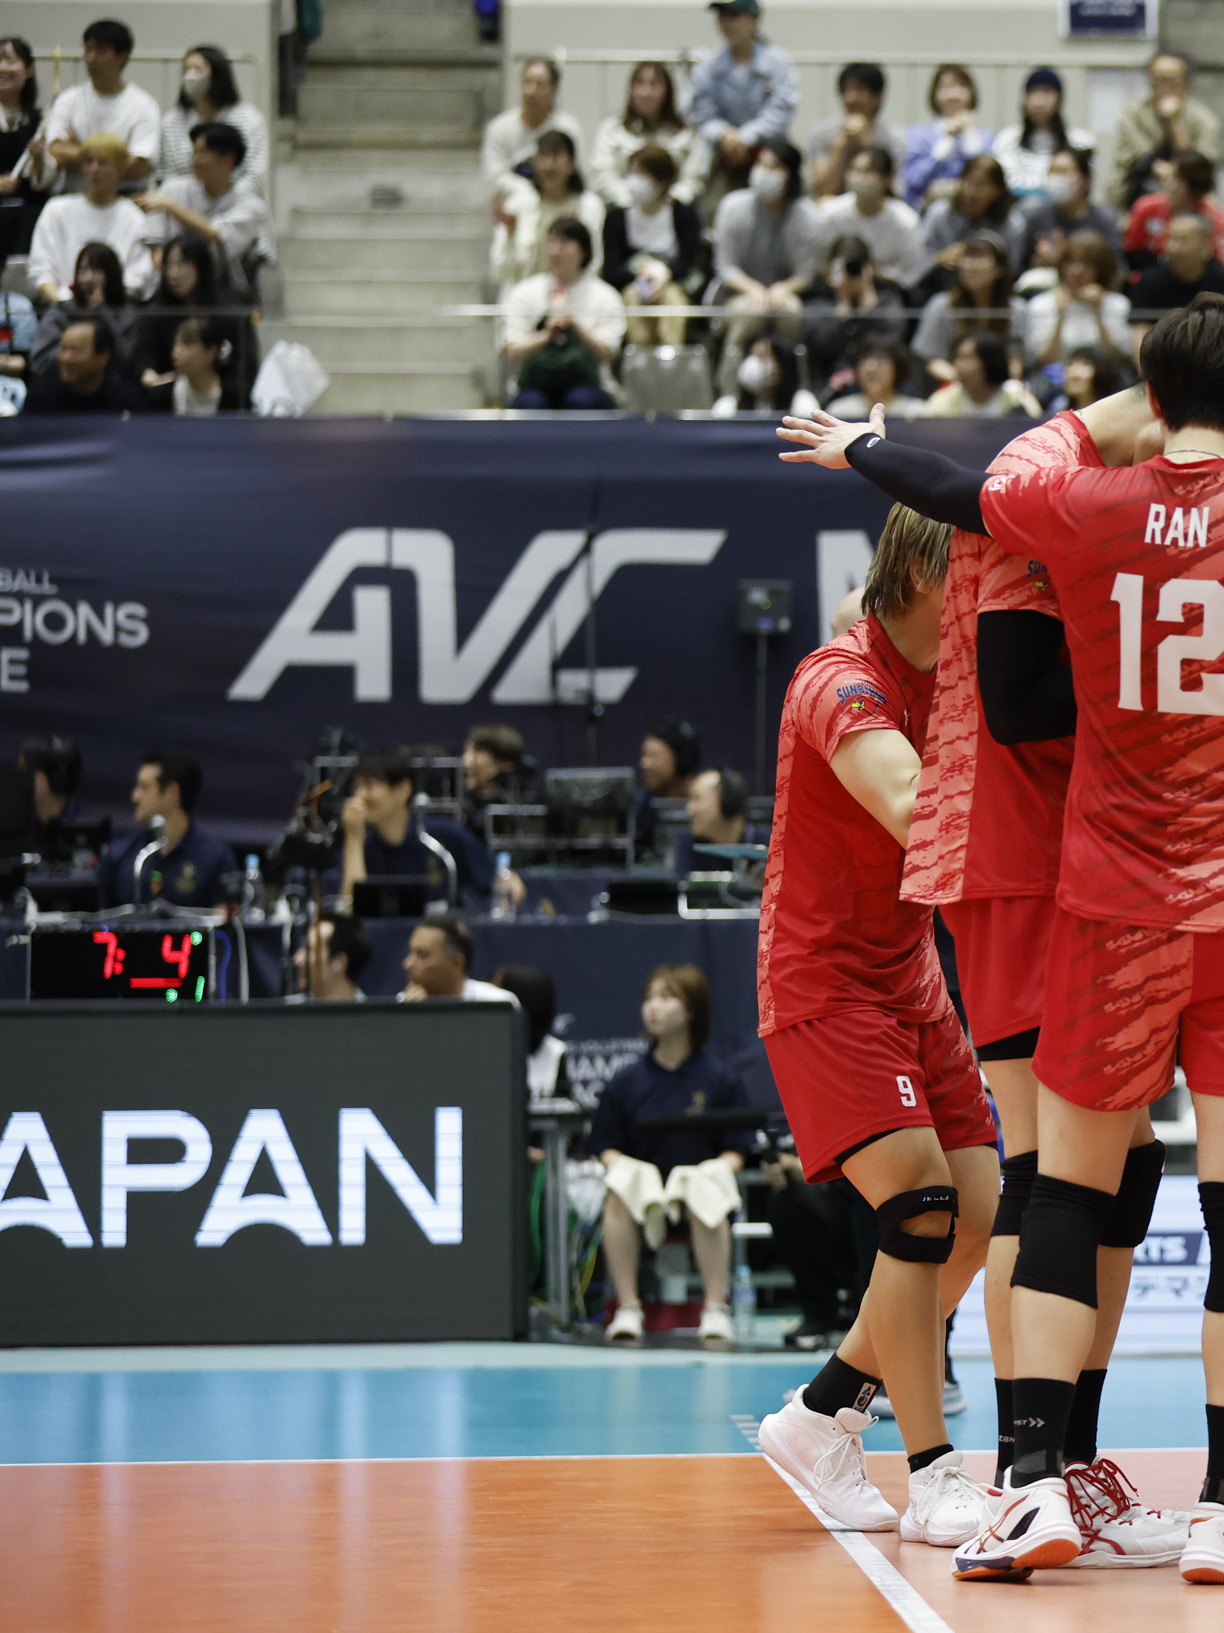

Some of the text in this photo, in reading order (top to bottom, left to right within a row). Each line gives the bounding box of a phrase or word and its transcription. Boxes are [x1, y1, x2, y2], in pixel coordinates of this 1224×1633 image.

[1144, 503, 1210, 548] RAN
[226, 526, 728, 705] AVC
[162, 934, 193, 980] 4
[896, 1075, 917, 1107] 9
[0, 1106, 463, 1248] APAN
